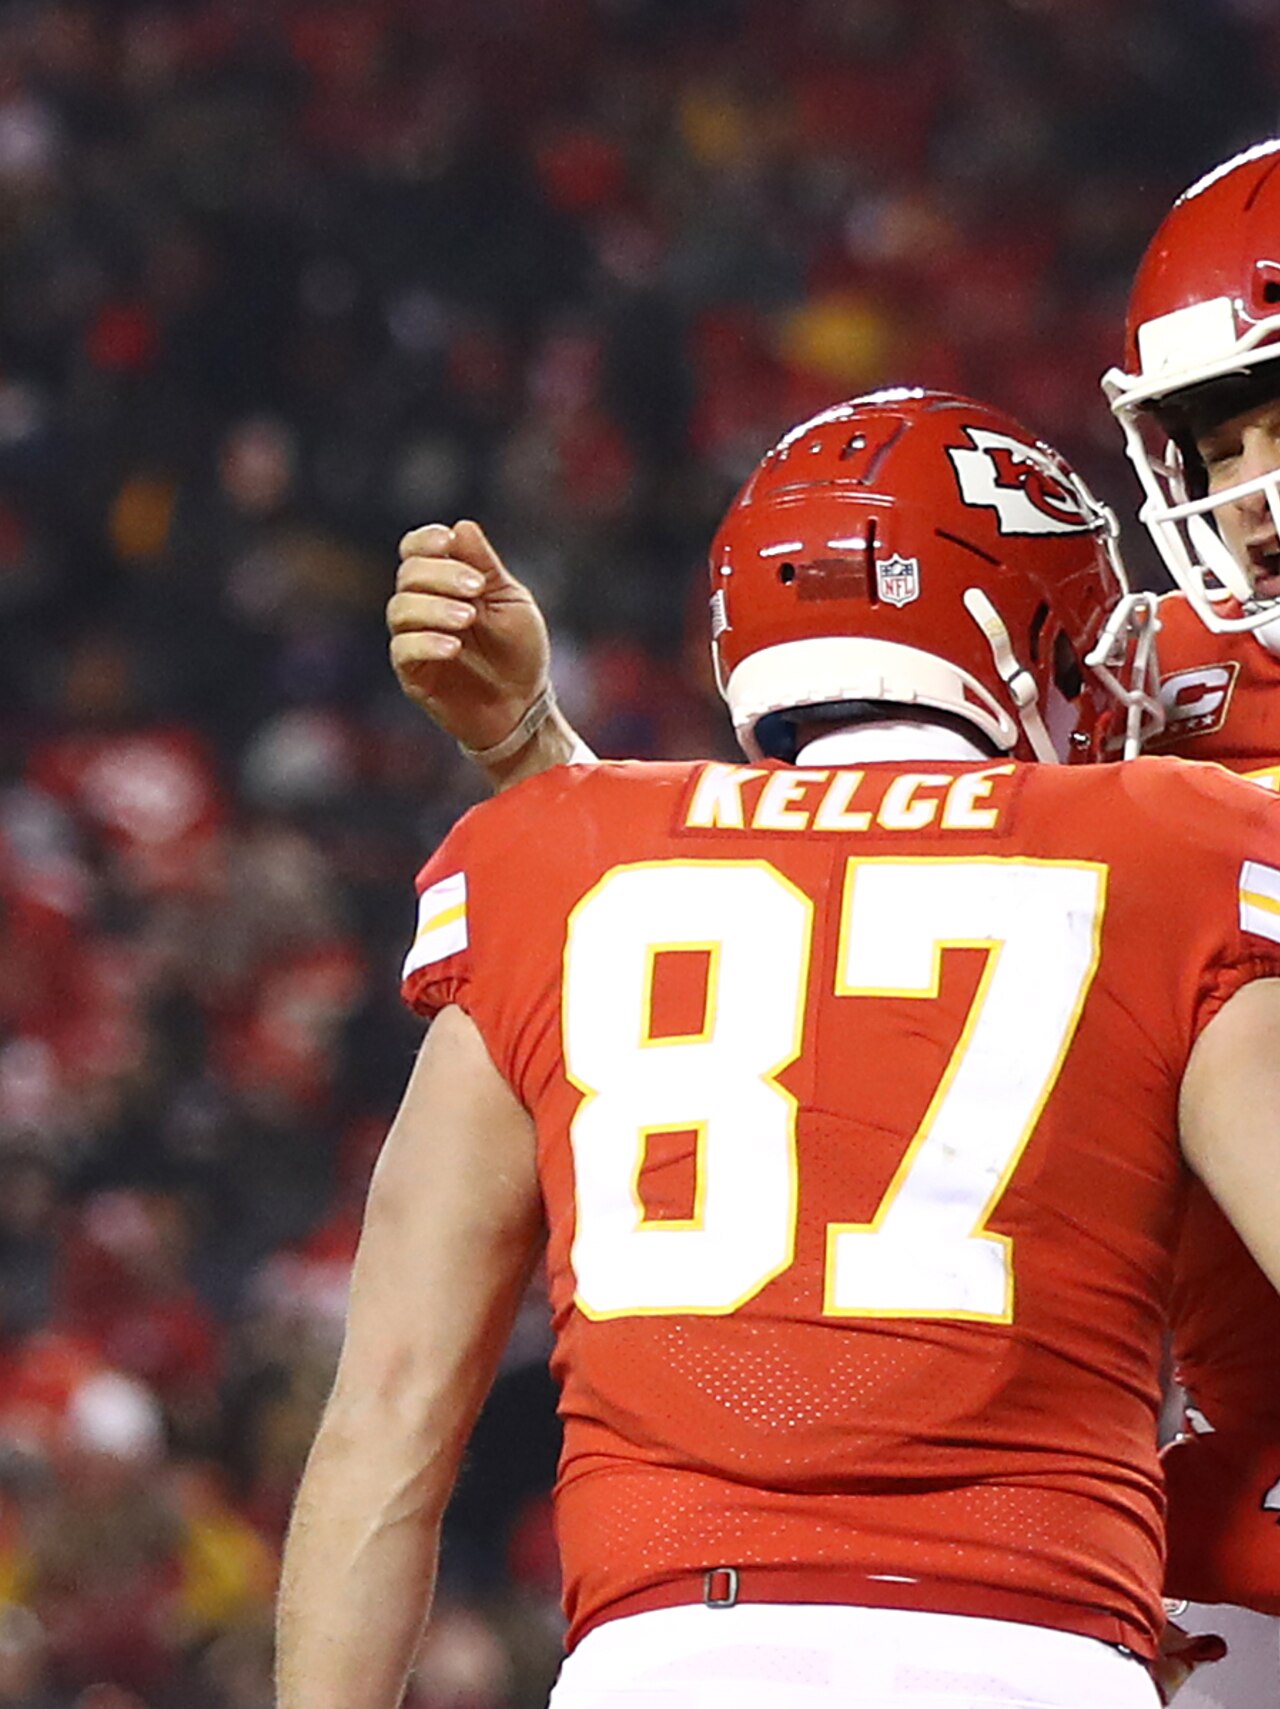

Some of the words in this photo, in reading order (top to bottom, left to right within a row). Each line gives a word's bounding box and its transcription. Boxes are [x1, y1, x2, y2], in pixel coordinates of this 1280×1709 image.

[1160, 668, 1229, 721] C
[684, 762, 1016, 832] KELCE
[561, 856, 1108, 1324] 87
